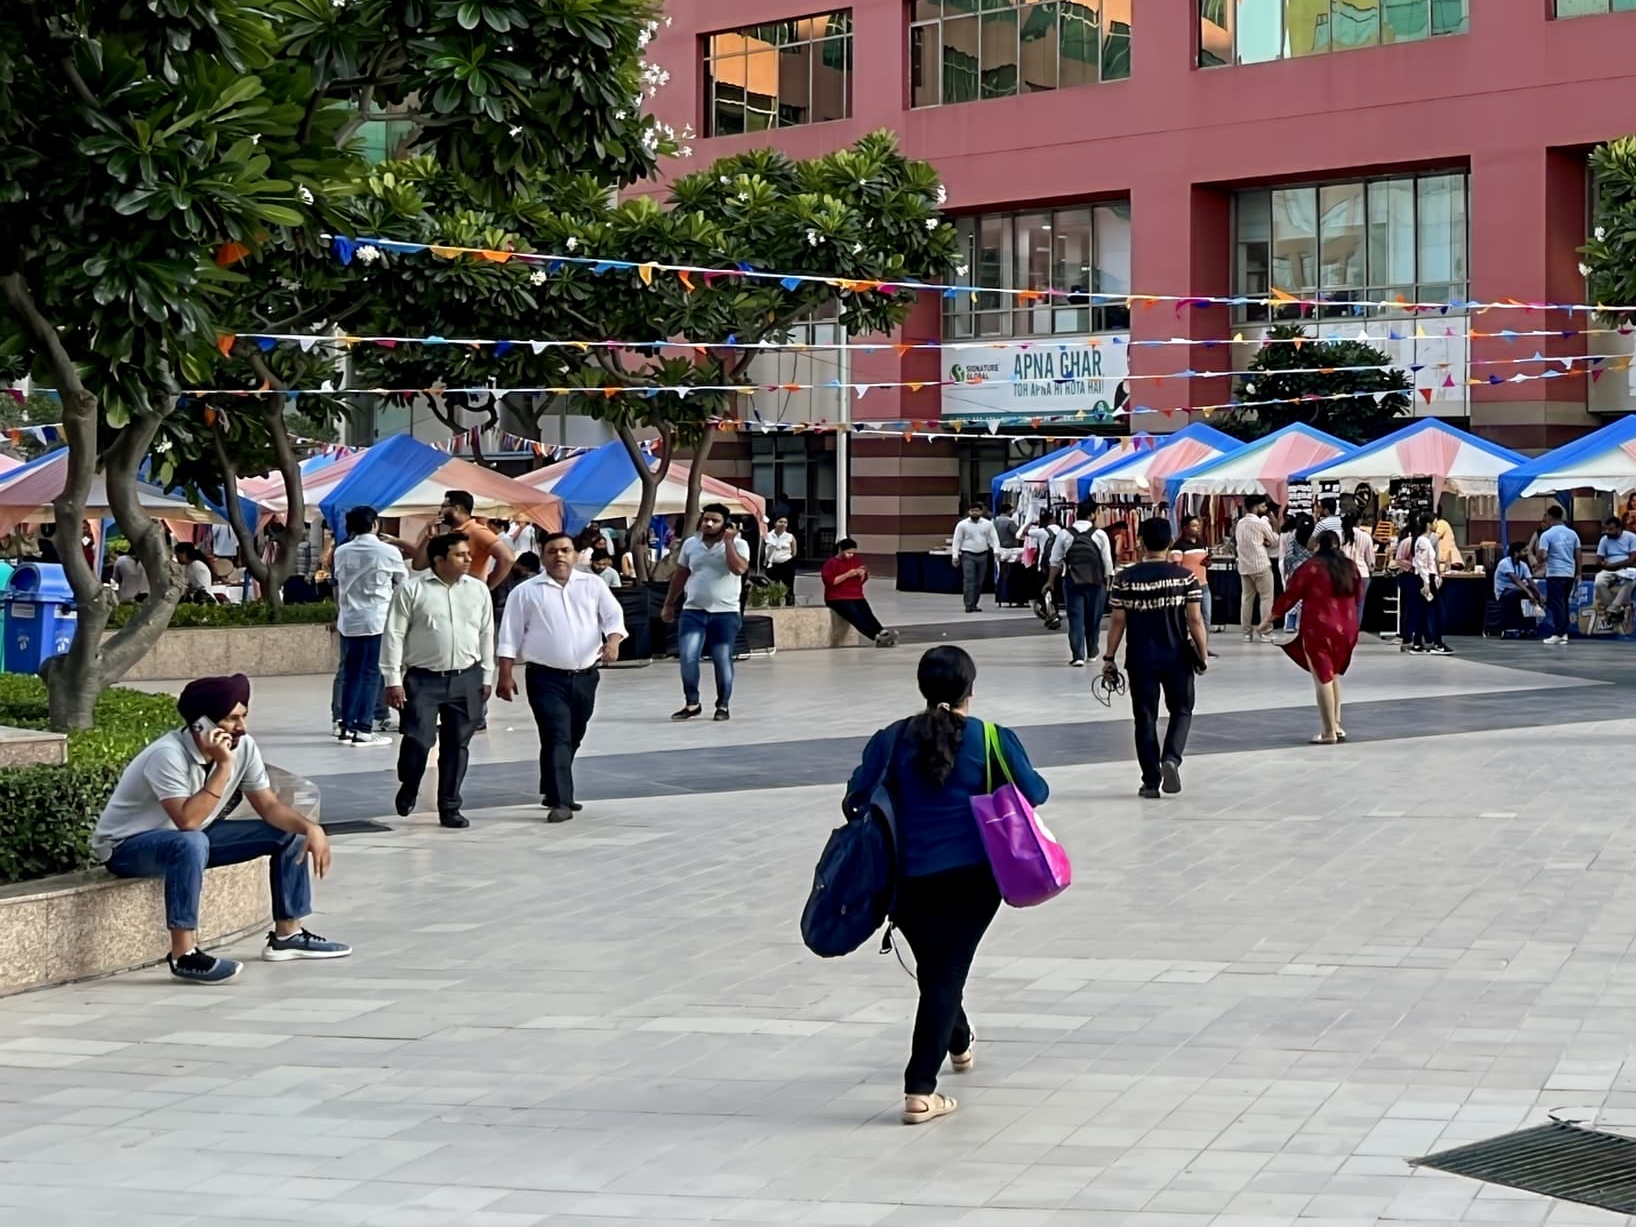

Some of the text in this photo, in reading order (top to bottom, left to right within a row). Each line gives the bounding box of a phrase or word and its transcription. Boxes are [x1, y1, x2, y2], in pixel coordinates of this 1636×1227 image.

[966, 364, 999, 372] SIGNATURE
[1014, 351, 1054, 380] APNA
[1014, 382, 1028, 397] TOH
[1065, 379, 1085, 395] HOTA
